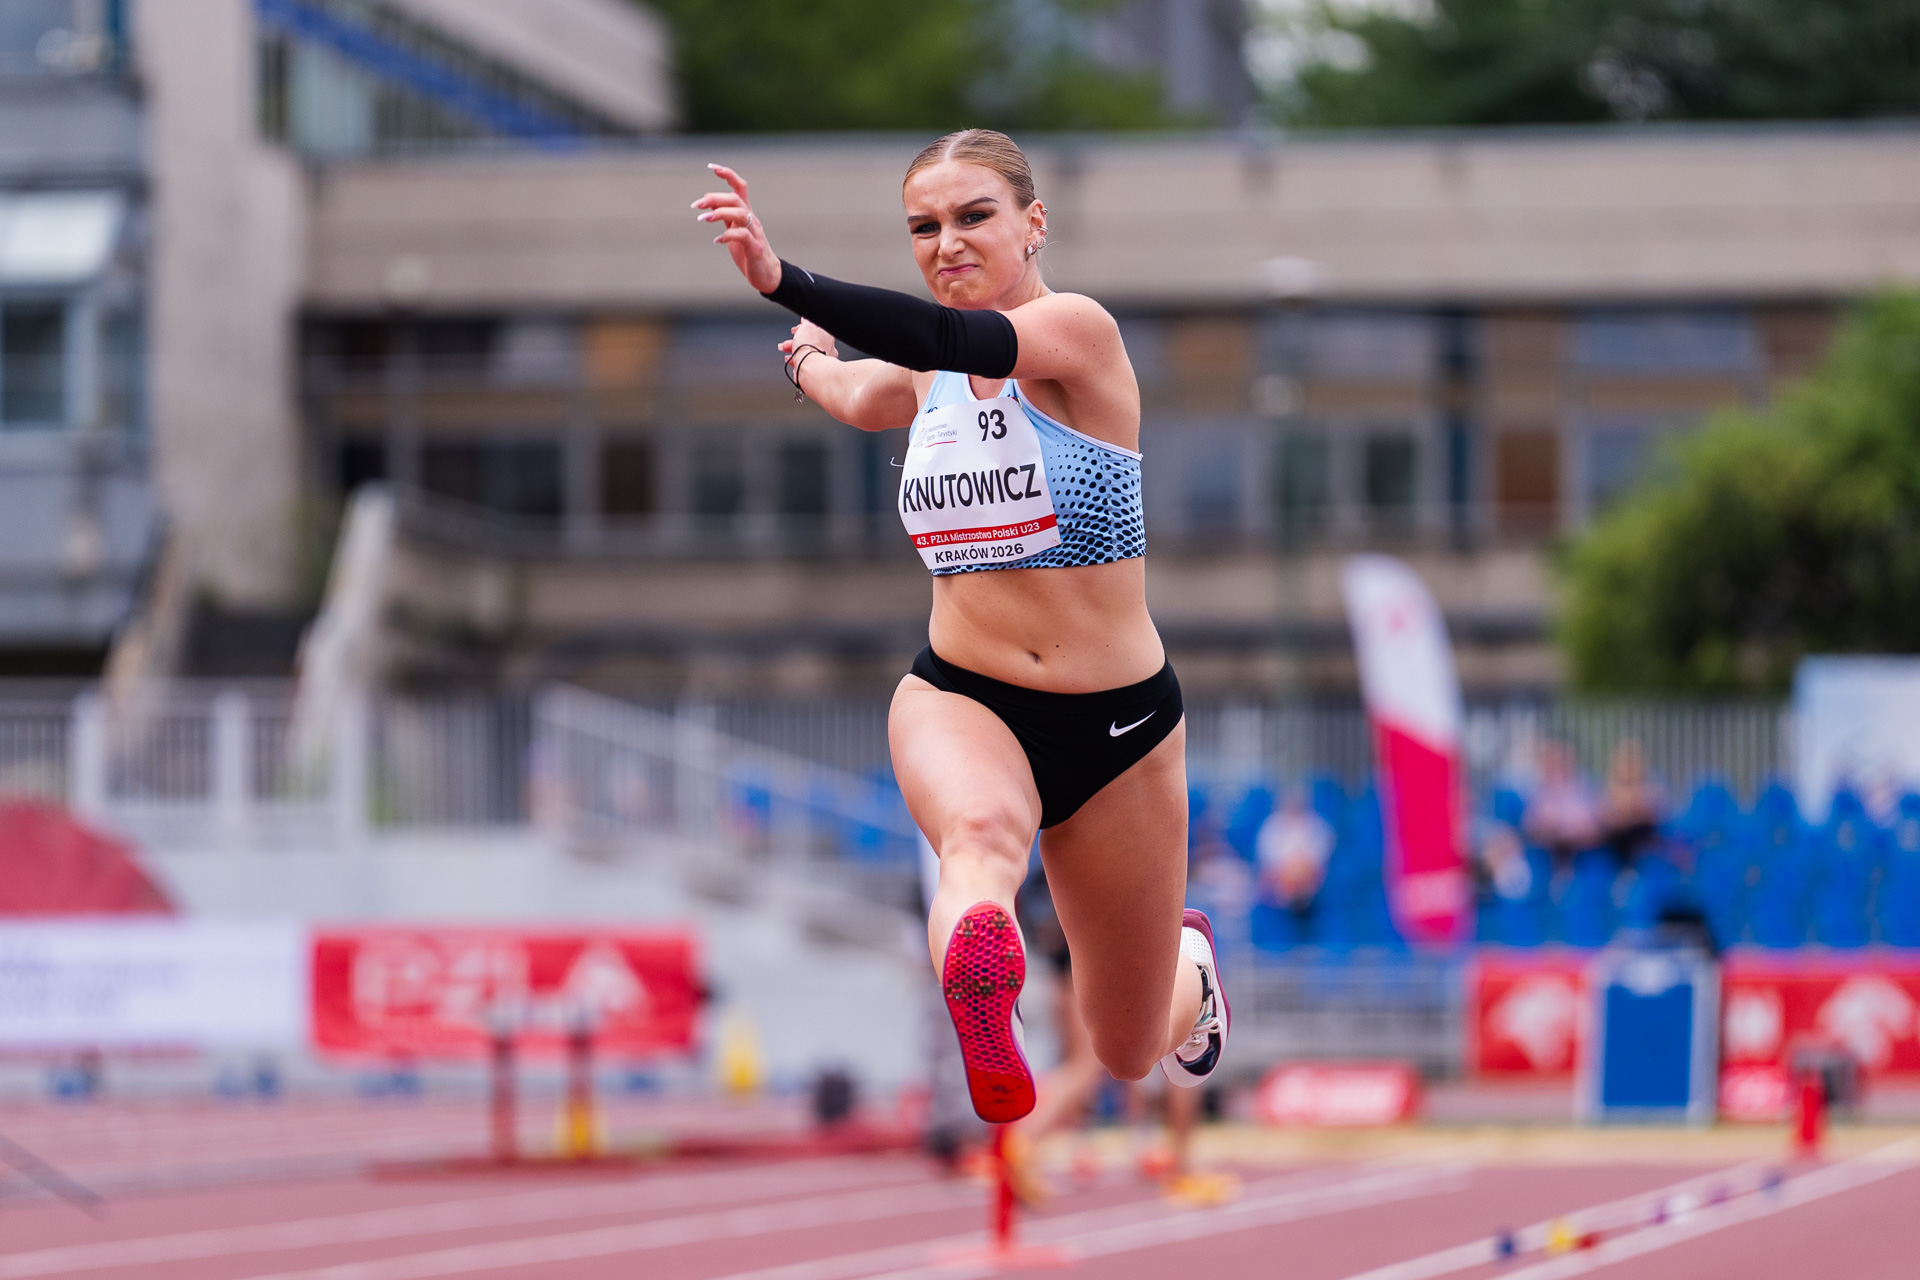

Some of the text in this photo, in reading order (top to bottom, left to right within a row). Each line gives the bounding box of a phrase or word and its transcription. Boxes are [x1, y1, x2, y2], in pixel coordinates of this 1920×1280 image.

[977, 409, 1008, 442] 93
[903, 463, 1042, 513] KNUTOWICZ
[916, 522, 1040, 546] 43. PZLA Mistrzostwa Polski U23
[934, 543, 1024, 564] KRAKÓW 2026
